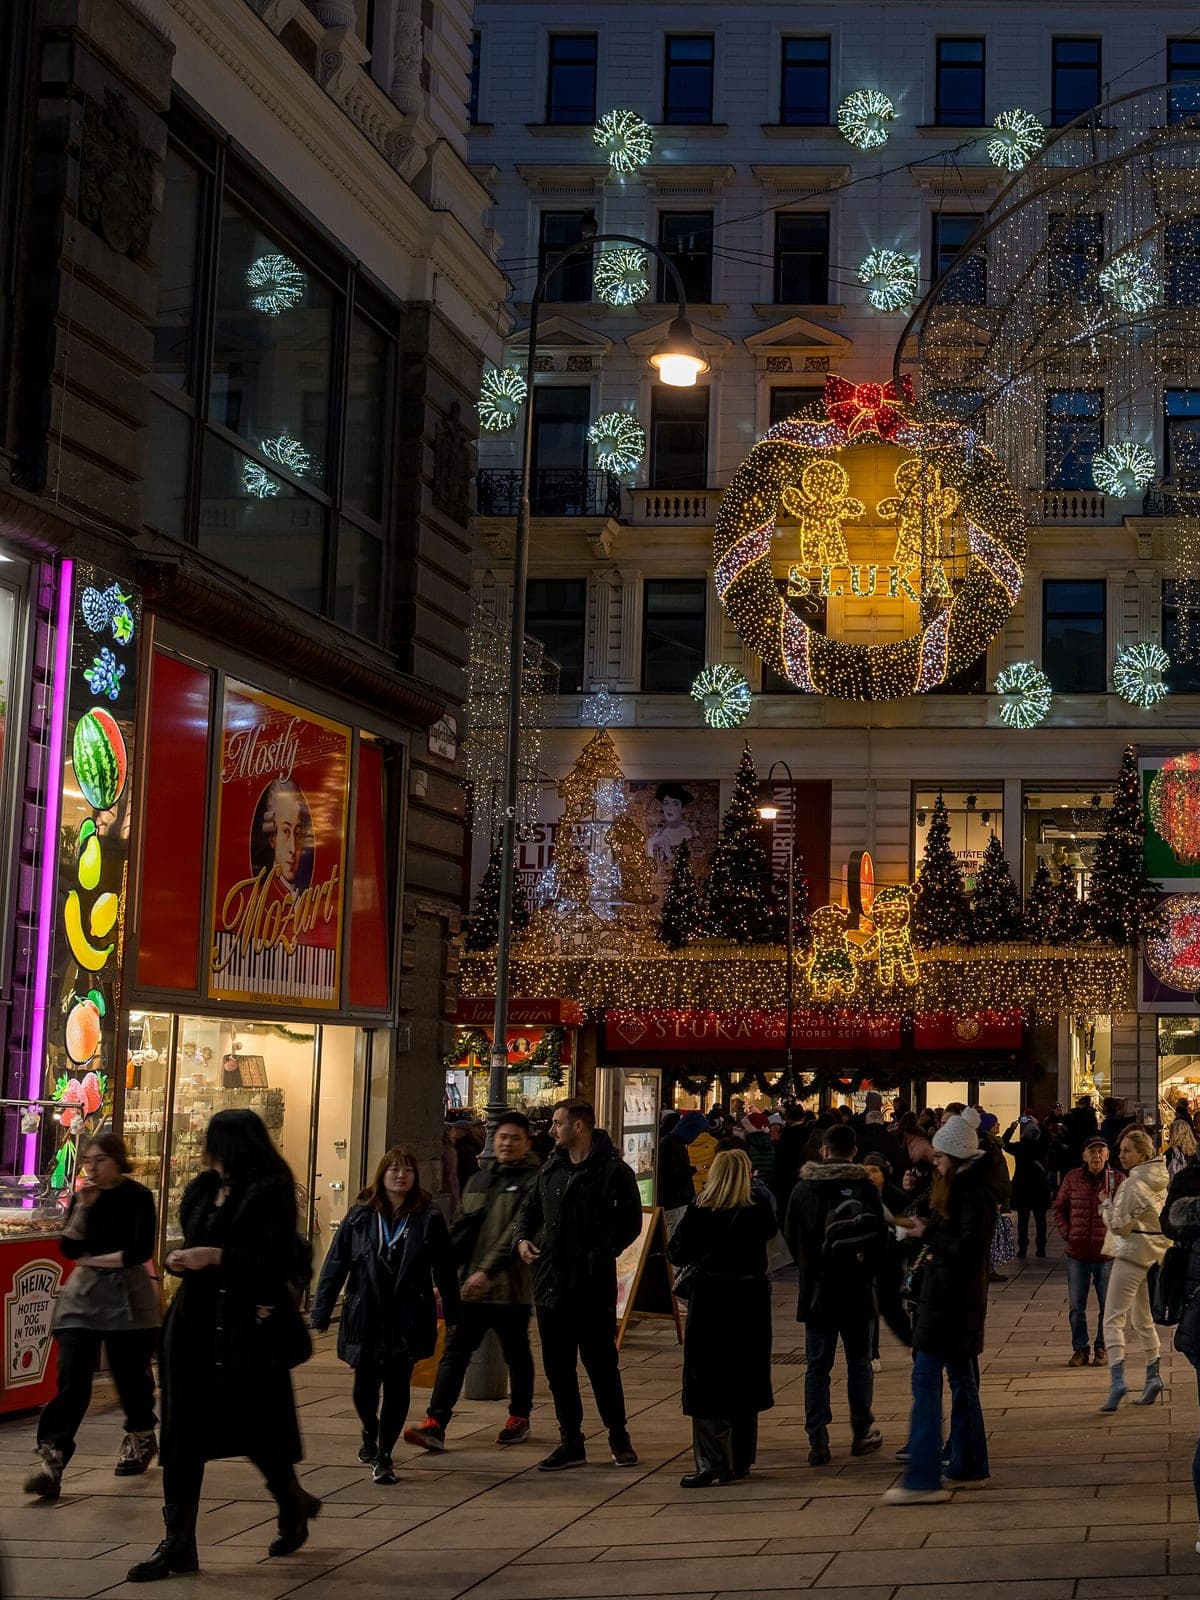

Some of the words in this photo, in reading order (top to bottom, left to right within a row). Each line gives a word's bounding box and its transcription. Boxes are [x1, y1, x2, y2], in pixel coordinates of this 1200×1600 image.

[787, 564, 954, 602] SLUKA
[220, 716, 301, 783] Mostly
[211, 863, 338, 972] Mozart
[656, 1020, 751, 1040] SLUKA
[838, 1029, 861, 1038] SEIT
[21, 1273, 53, 1297] HEINZ
[18, 1301, 49, 1315] HOTTEST
[24, 1313, 40, 1326] DOG
[14, 1328, 22, 1339] IN
[24, 1324, 47, 1337] TOWN
